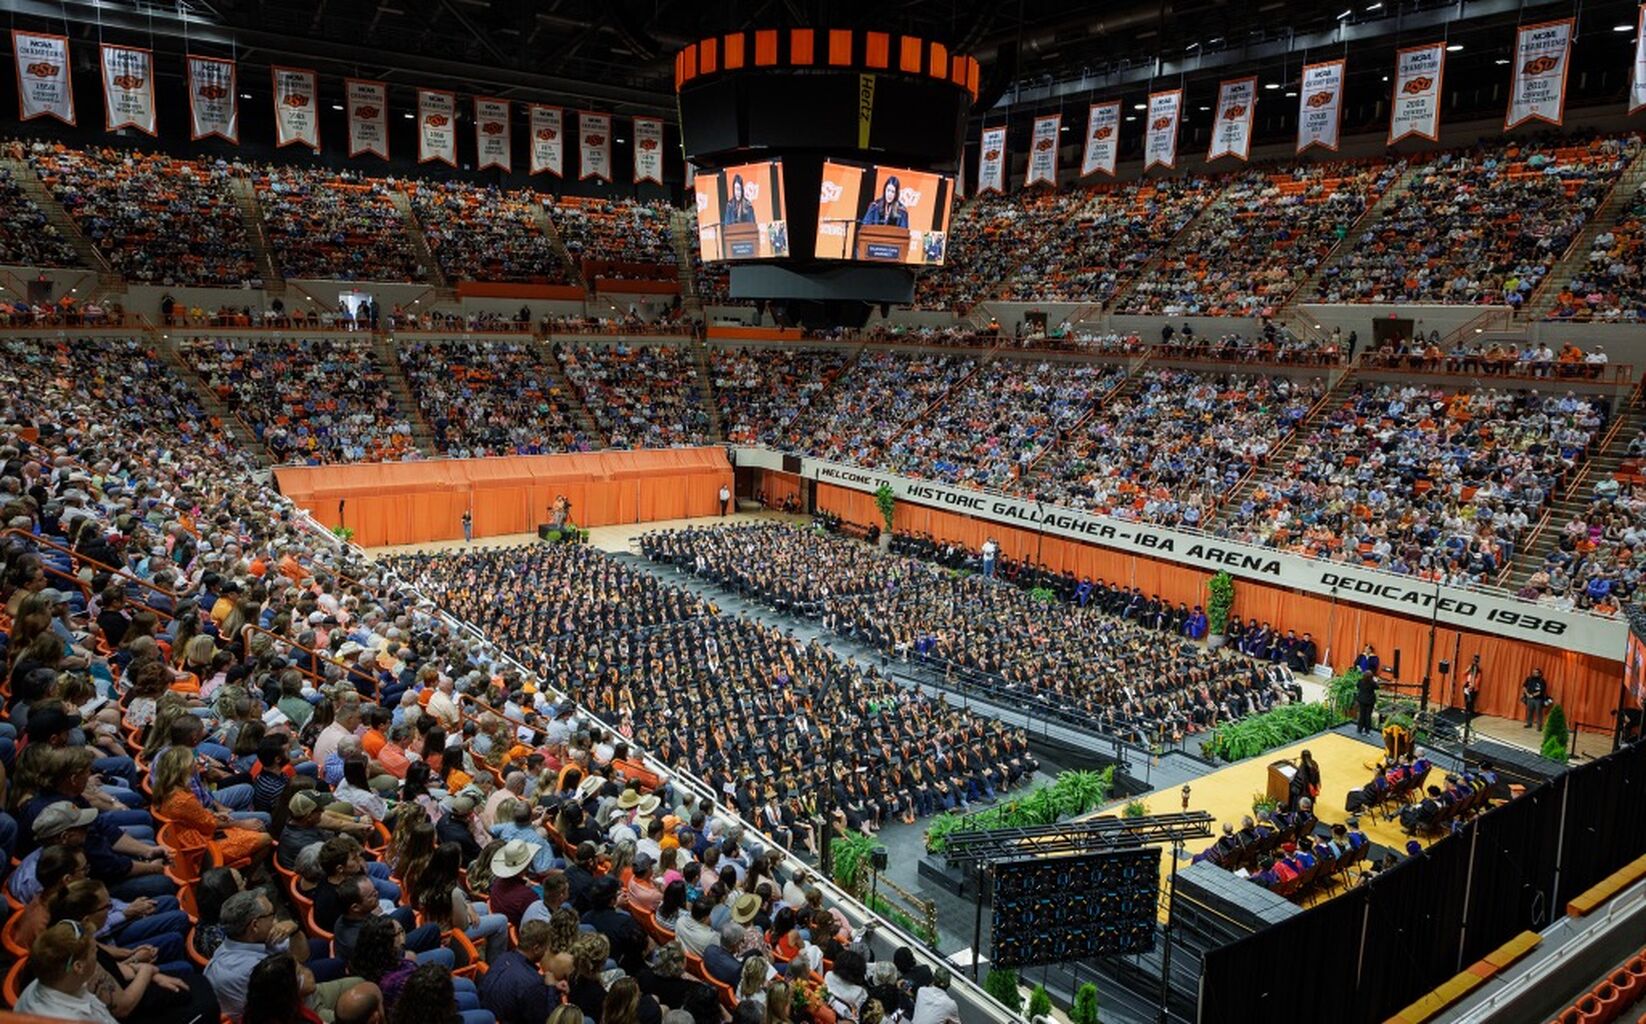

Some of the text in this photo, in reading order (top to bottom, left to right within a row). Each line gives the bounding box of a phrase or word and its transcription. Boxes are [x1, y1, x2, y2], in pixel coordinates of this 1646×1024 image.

[1532, 30, 1556, 40] NCAA
[1411, 54, 1432, 62] NCAA
[1521, 56, 1559, 75] OSU
[26, 62, 60, 78] OSU
[113, 74, 144, 90] OSU
[1402, 77, 1433, 95] OSU
[283, 94, 310, 108] OSU
[862, 76, 873, 122] Hertz
[1306, 91, 1334, 108] OSU
[355, 106, 380, 119] OSU
[426, 114, 449, 127] OSU
[821, 467, 1568, 636] WELCOME TO HISTORIC GALLAGHER-IBA ARENA DEDICATED 1938
